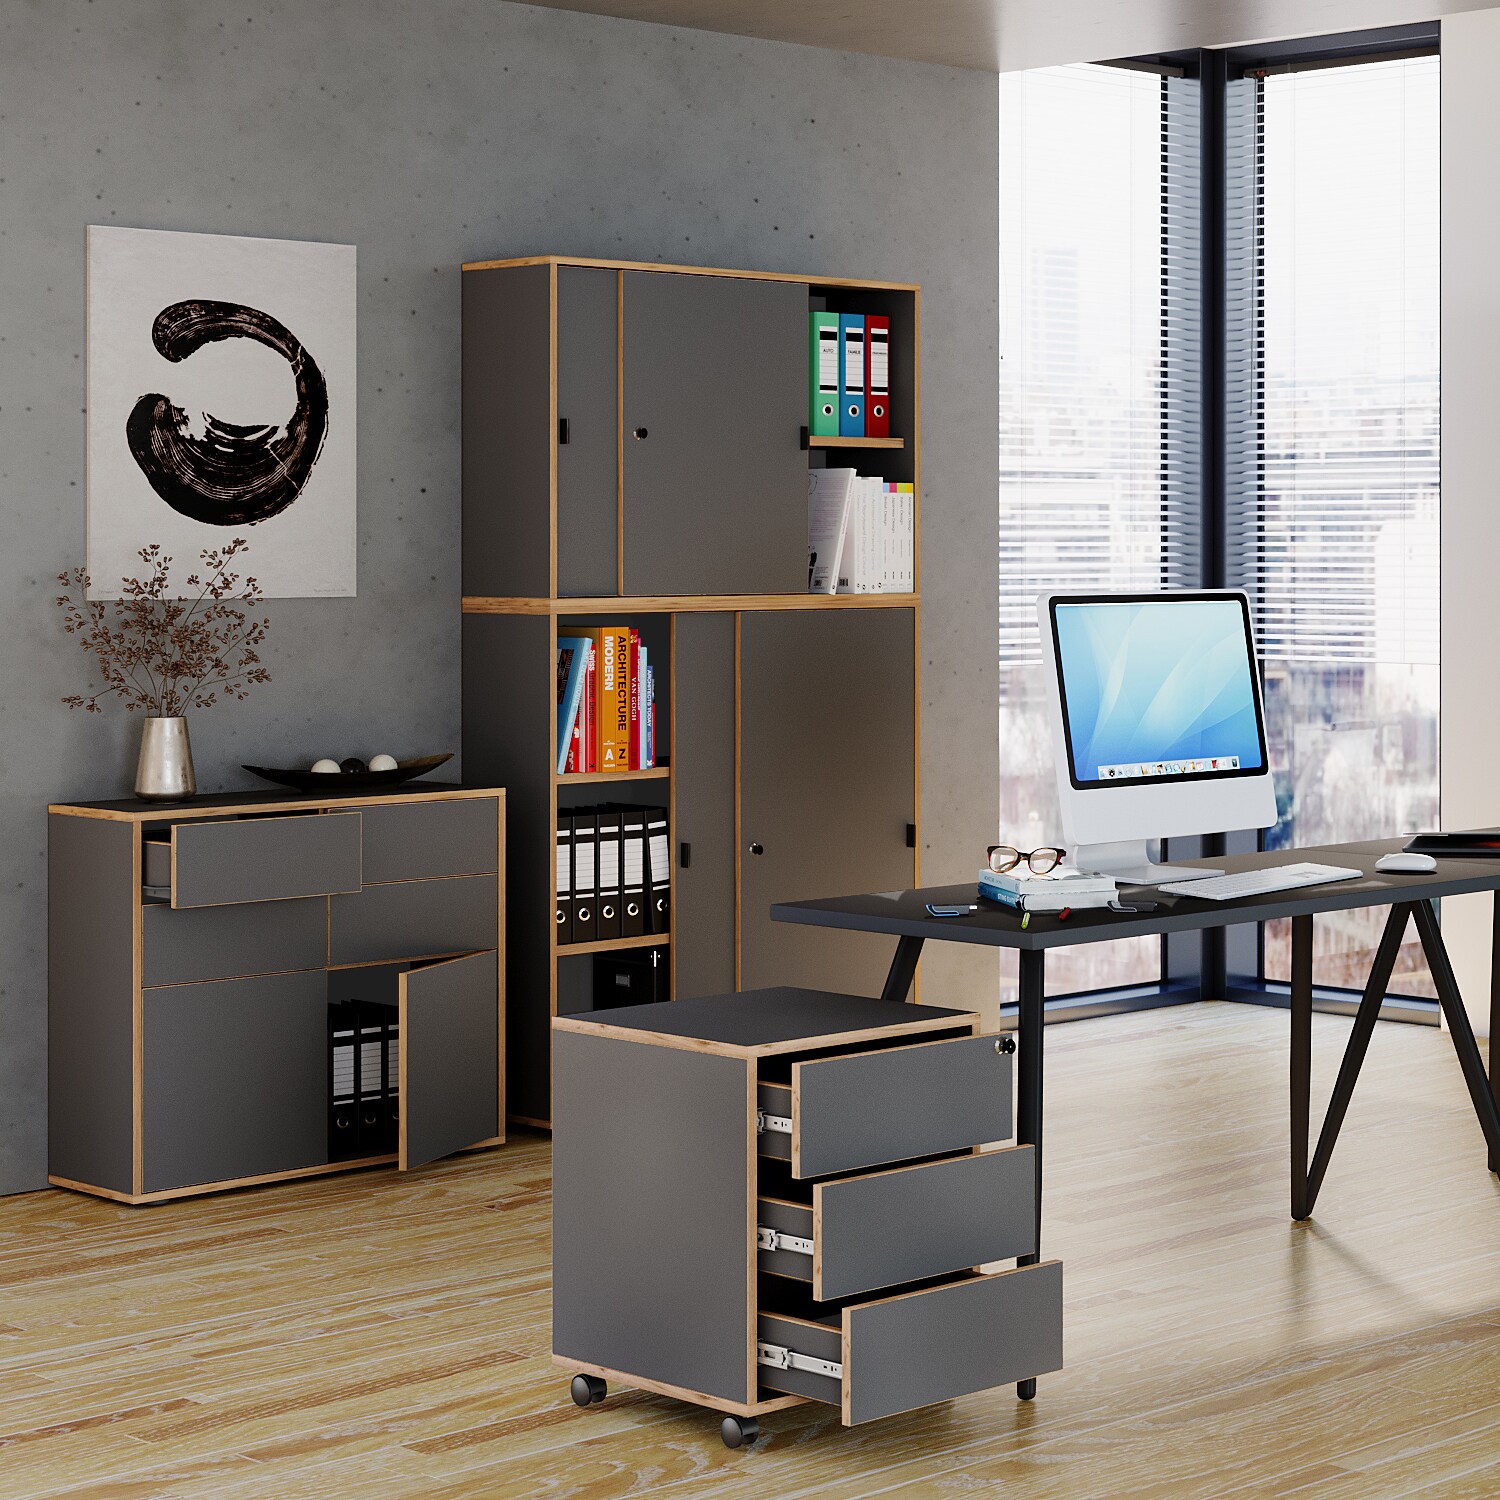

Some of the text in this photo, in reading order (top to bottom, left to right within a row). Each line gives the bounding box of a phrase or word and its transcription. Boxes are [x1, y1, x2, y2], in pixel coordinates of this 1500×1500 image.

[588, 649, 596, 671] Swiss
[604, 635, 614, 691] MODERN
[617, 635, 627, 731] ARCHITECTURE
[605, 748, 614, 761] A
[618, 748, 626, 759] Z
